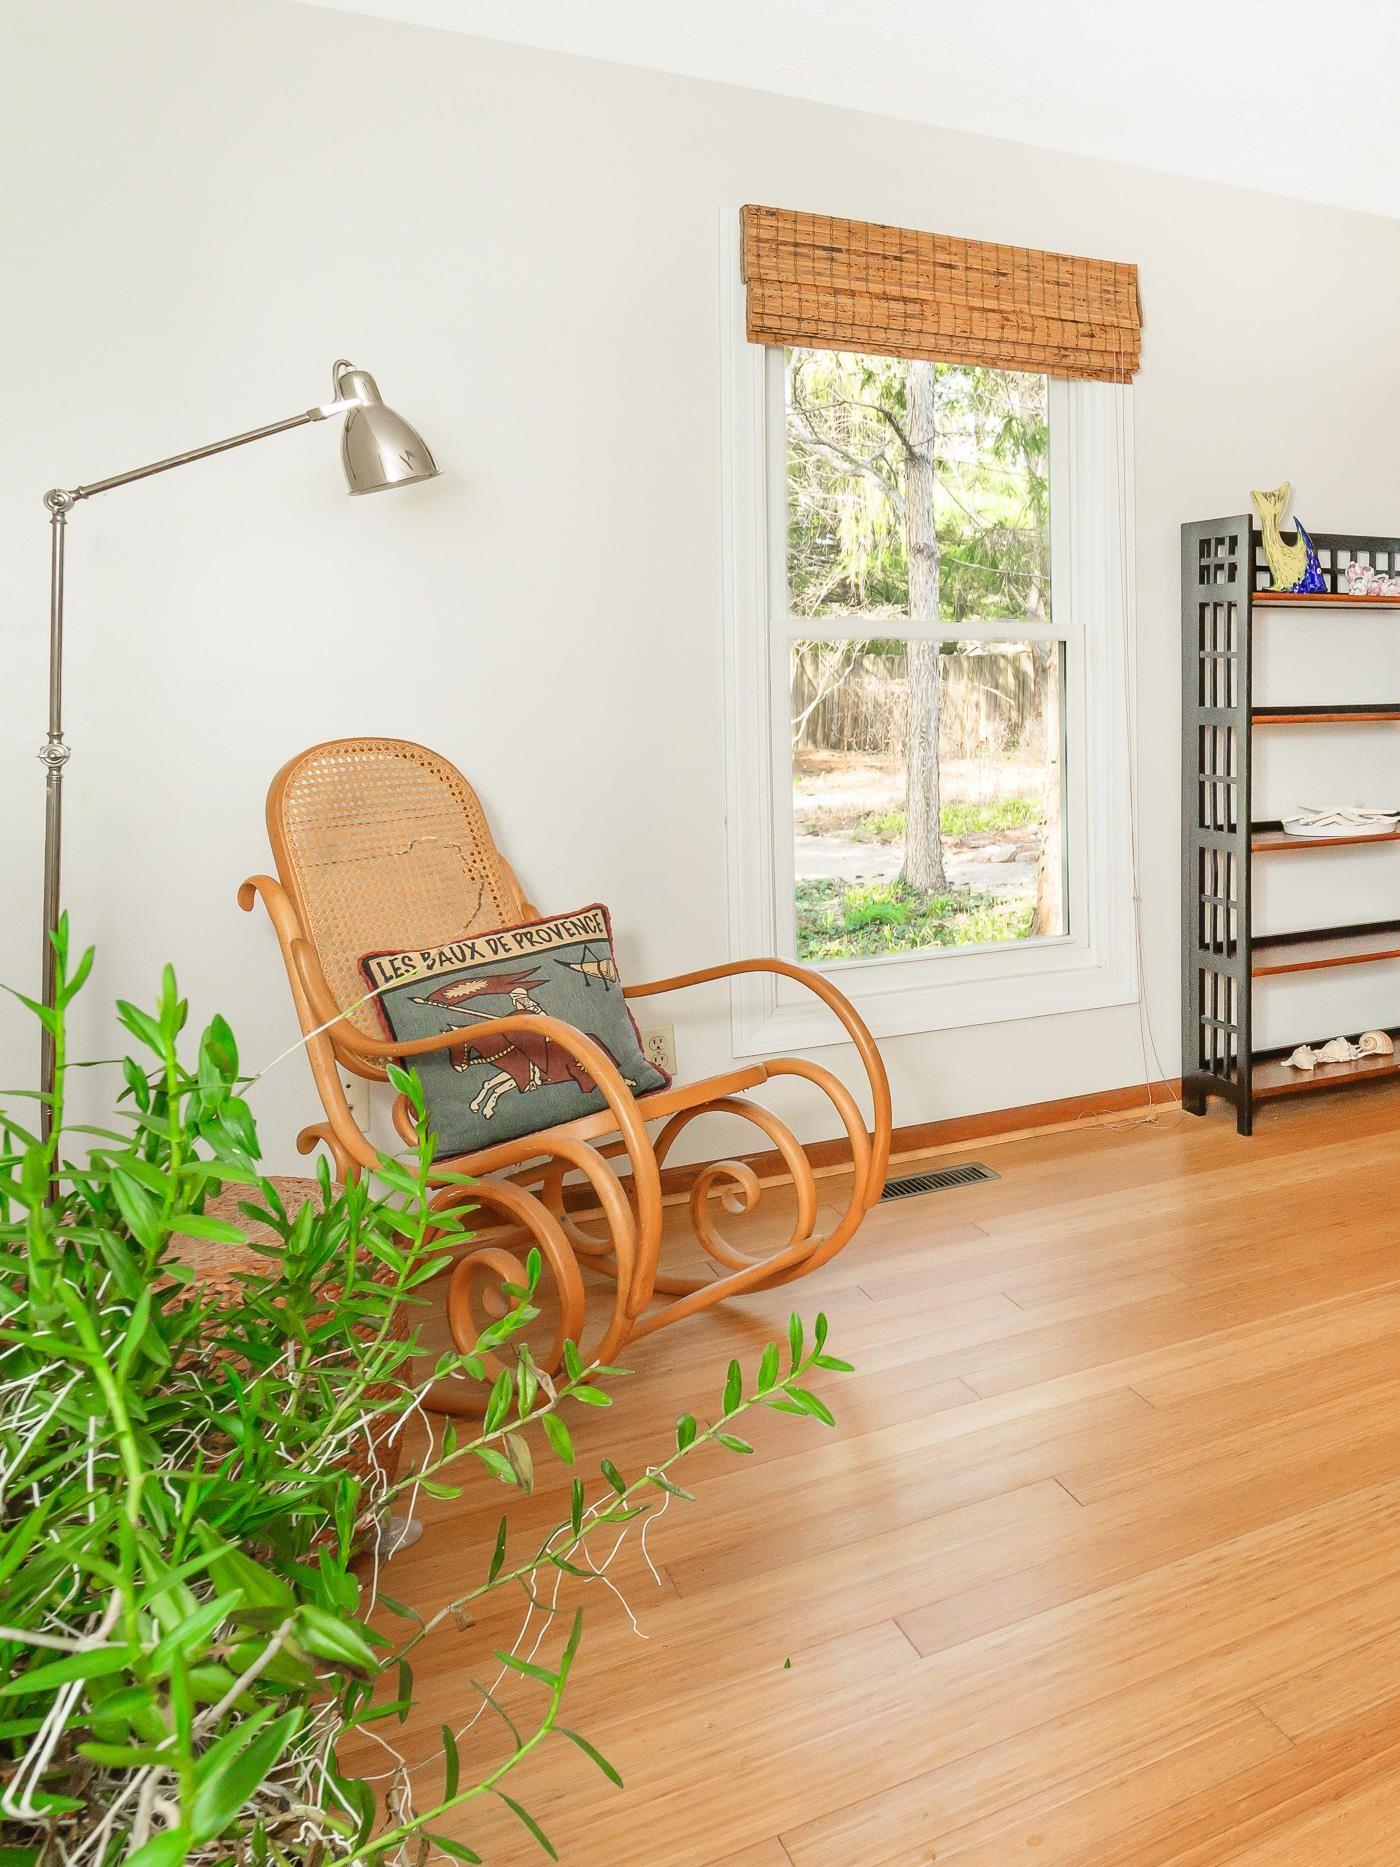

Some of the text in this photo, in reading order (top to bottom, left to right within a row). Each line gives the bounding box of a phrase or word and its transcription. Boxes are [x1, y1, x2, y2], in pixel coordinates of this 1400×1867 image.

[376, 913, 604, 983] LES BAUX DE PROVENCE
